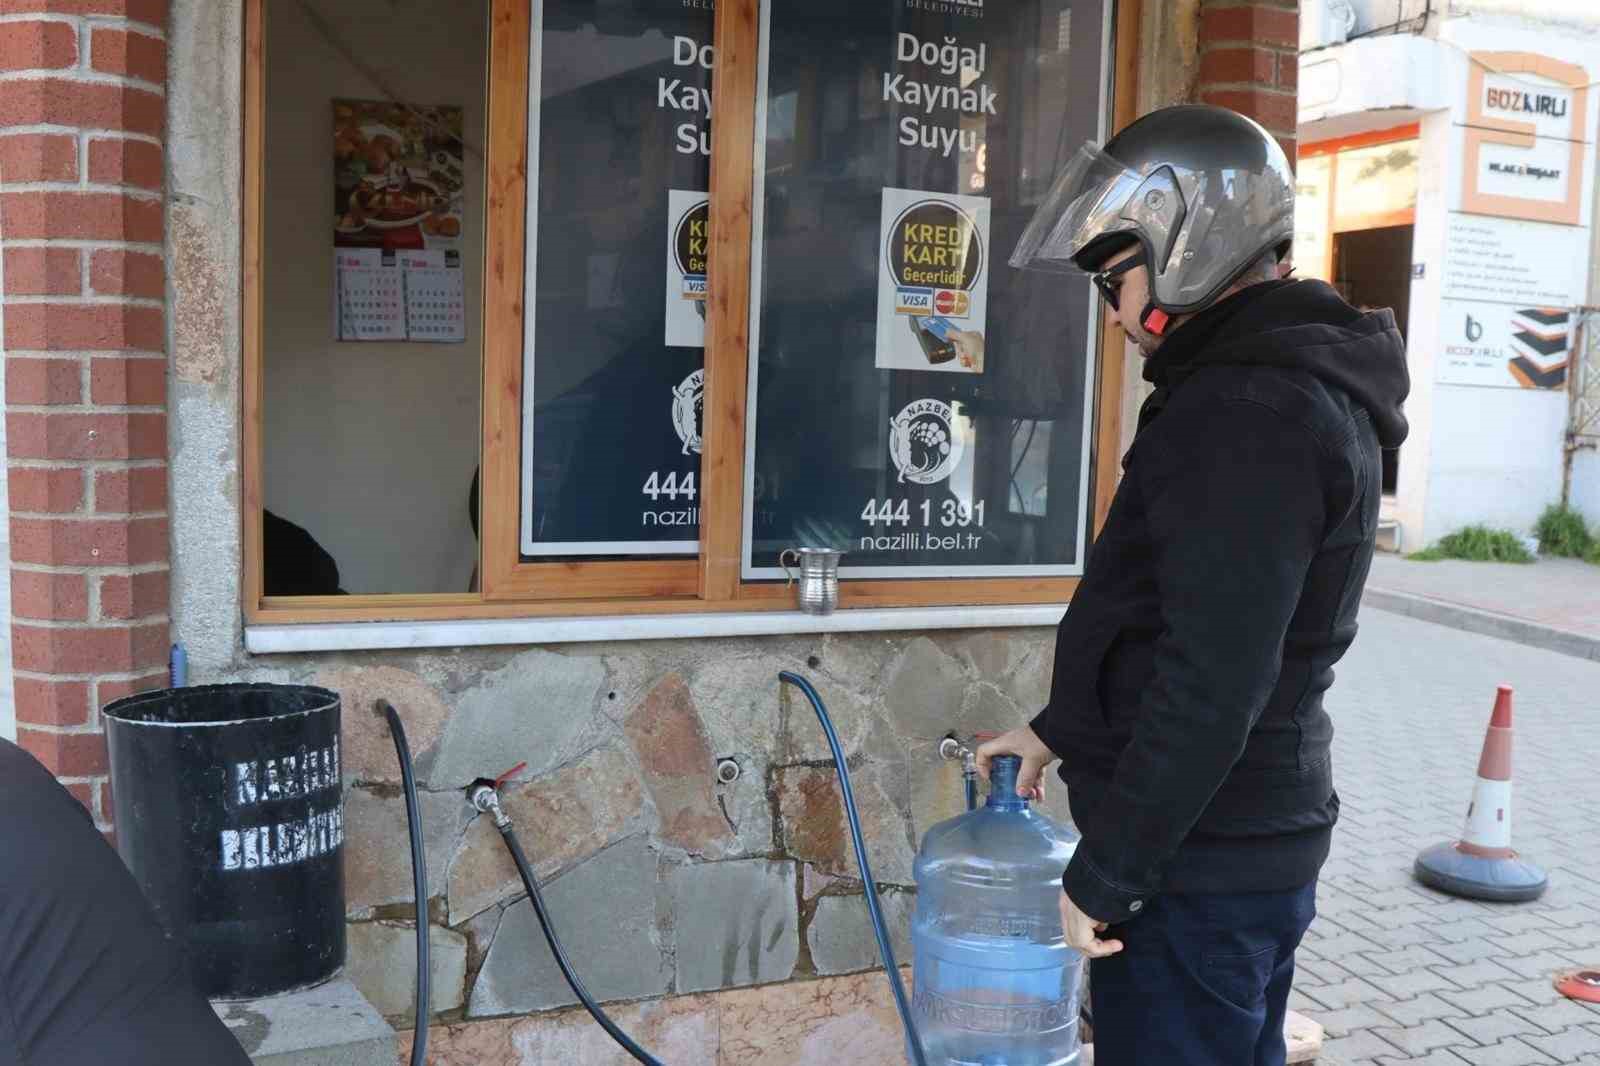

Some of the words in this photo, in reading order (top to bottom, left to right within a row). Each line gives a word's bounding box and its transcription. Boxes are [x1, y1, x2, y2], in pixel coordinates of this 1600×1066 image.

[897, 32, 986, 75] Doğal
[883, 72, 998, 115] Kaynak
[899, 116, 977, 157] Suyu
[903, 267, 967, 285] Geçerlidir
[903, 295, 928, 306] VISA
[642, 472, 697, 500] 444
[861, 498, 911, 527] 444
[920, 498, 931, 527] 1
[940, 498, 985, 527] 391
[860, 532, 982, 551] nazilli.bel.tr
